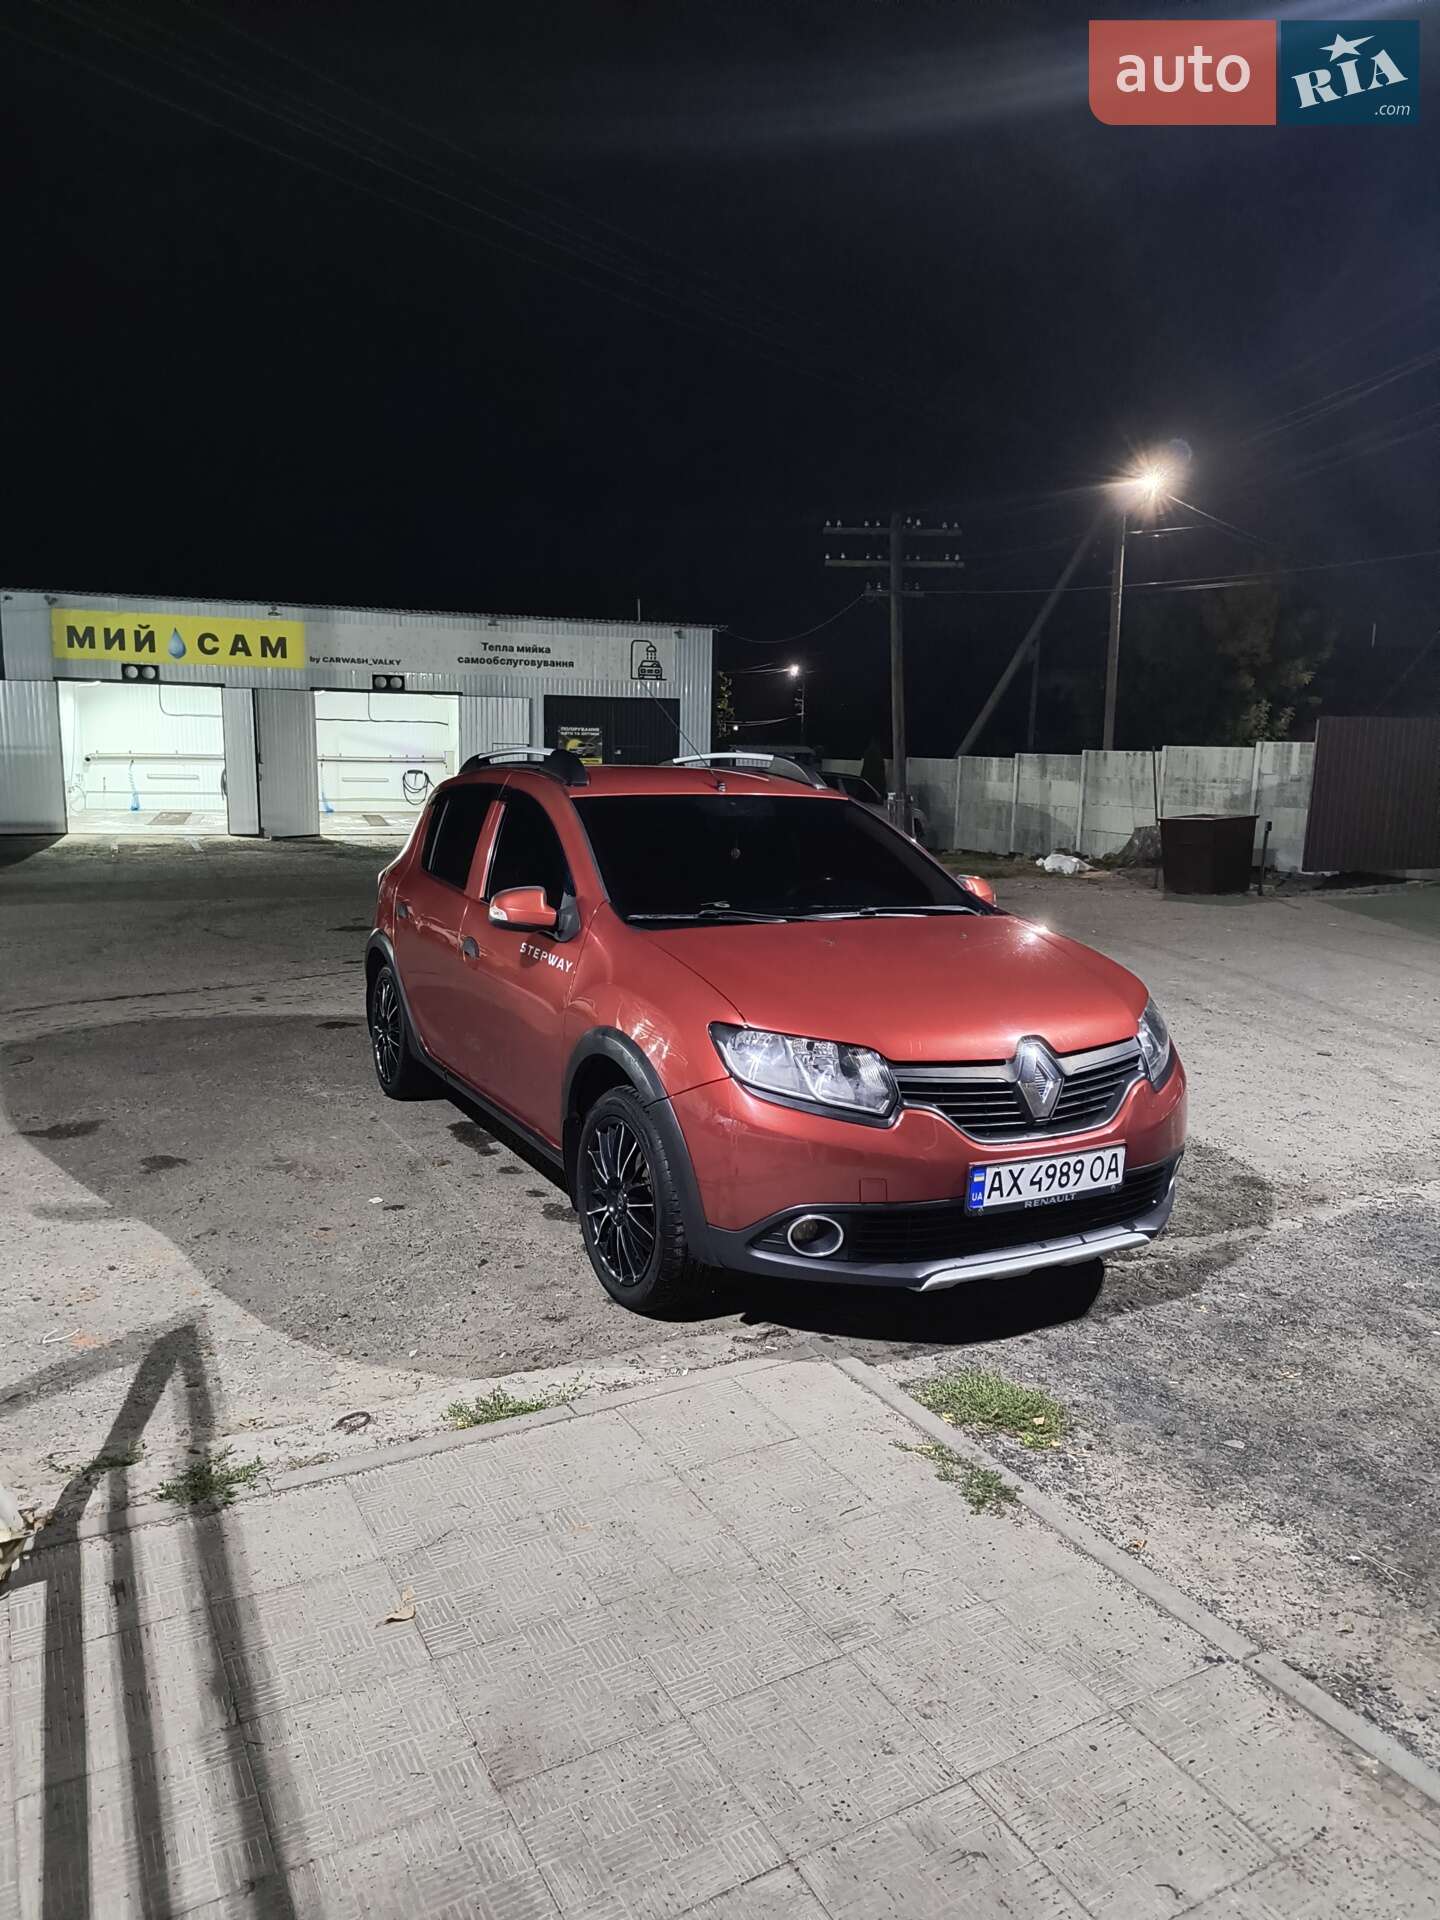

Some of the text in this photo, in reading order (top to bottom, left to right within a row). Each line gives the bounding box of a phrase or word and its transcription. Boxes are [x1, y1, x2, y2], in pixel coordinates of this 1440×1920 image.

[66, 624, 288, 659] МИЙ САМ
[481, 642, 552, 654] Тепла мийка
[309, 656, 402, 666] by CARWASH_VALKY
[457, 656, 575, 669] самообслуговування
[520, 942, 573, 973] STEPWAY
[986, 1153, 1120, 1200] AX 4989 OA
[971, 1192, 984, 1202] UA
[1024, 1193, 1077, 1209] RENAULT
